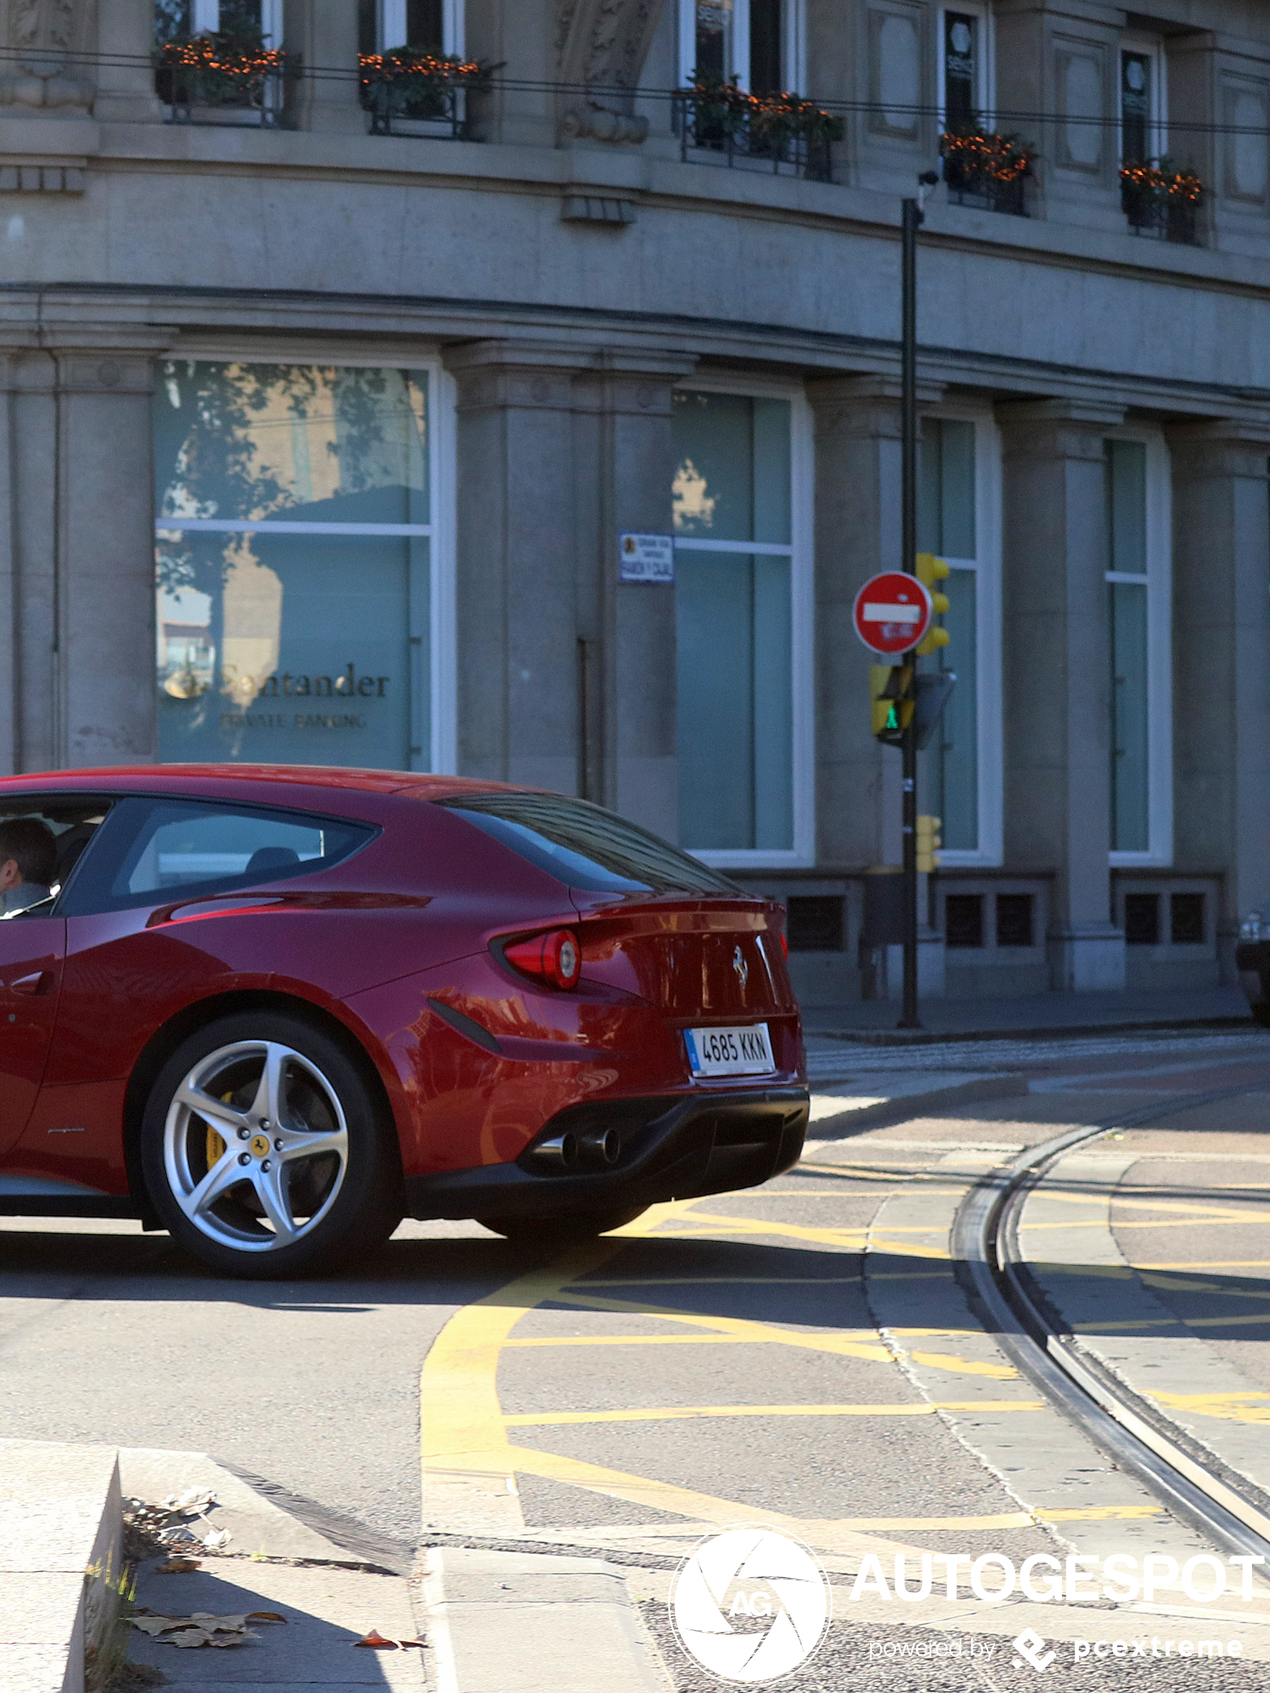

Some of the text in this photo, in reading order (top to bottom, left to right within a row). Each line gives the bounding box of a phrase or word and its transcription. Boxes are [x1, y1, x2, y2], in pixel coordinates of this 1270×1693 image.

[220, 662, 390, 698] Santander
[702, 1032, 767, 1063] 4685 KKN
